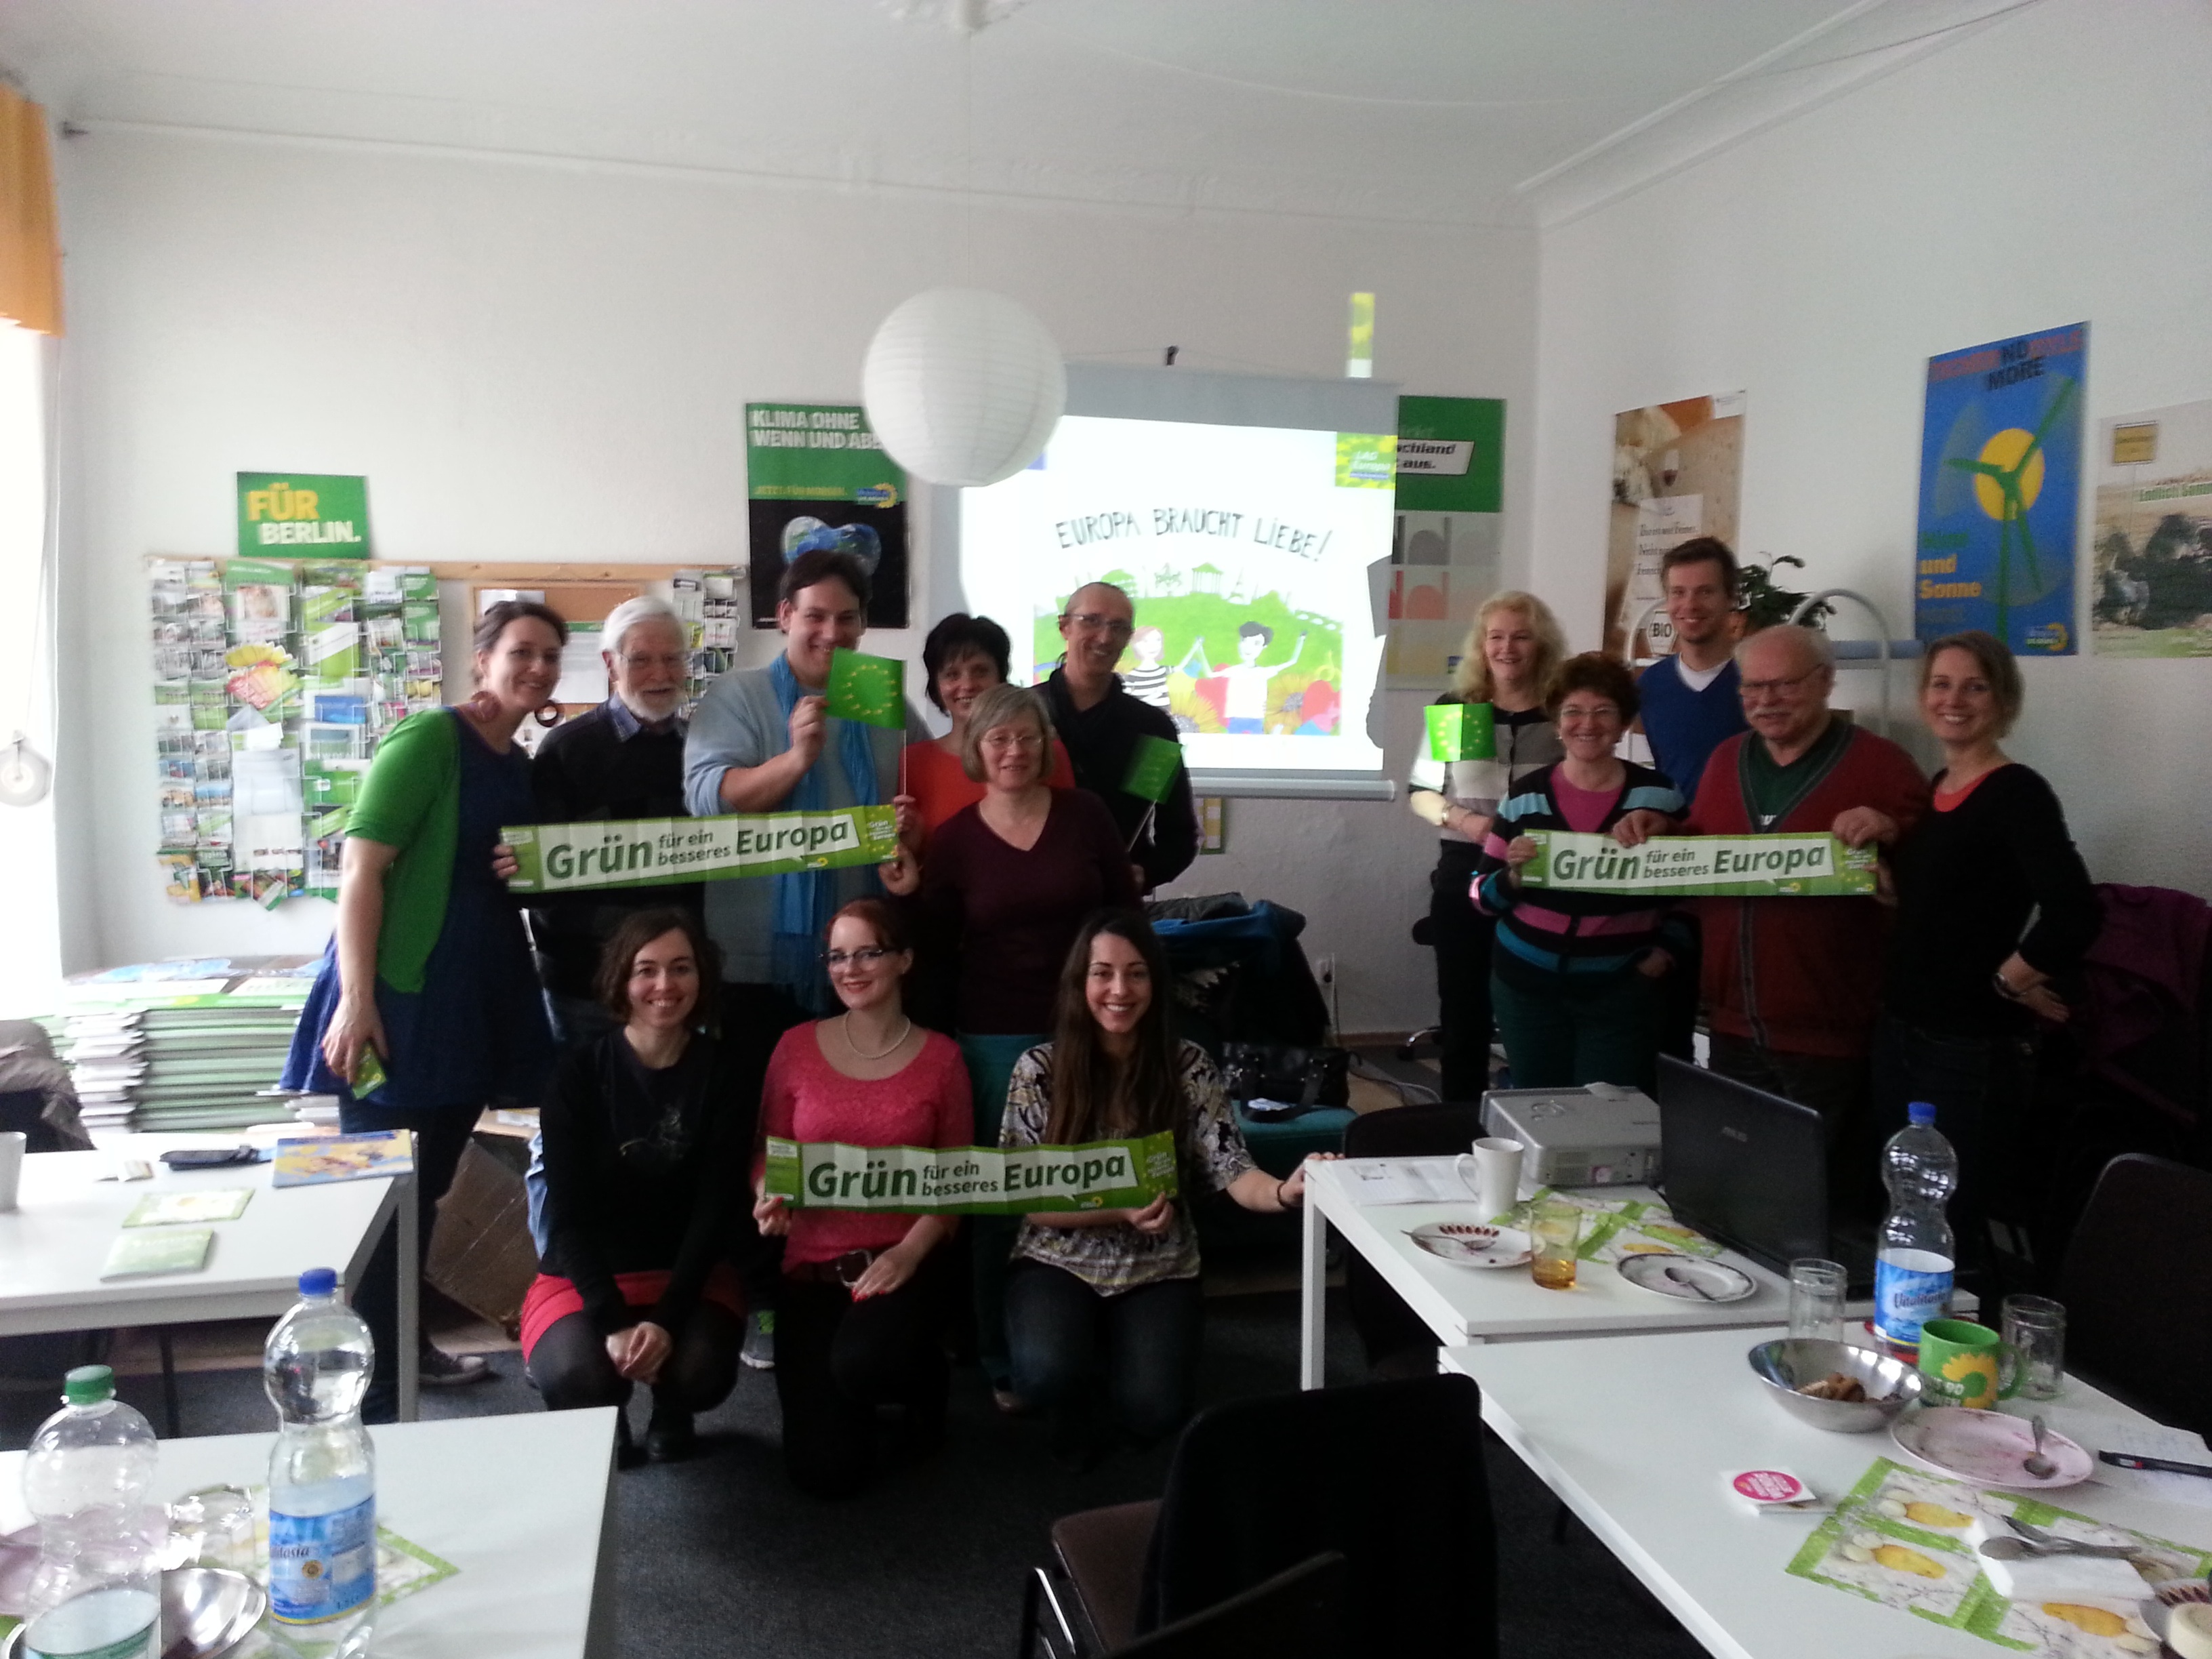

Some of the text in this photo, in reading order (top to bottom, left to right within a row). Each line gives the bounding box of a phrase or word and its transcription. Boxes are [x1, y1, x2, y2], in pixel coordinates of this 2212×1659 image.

[1988, 357, 2045, 390] MORE
[752, 410, 860, 430] KLIMA OHNE
[753, 430, 883, 450] WENN UND ABE
[1403, 459, 1436, 469] aus.
[247, 482, 320, 522] FÜR
[259, 520, 361, 546] BERLIN.
[1056, 511, 1141, 549] EUROPA
[1153, 507, 1244, 536] BRAUCHT
[1920, 553, 1958, 574] und
[1921, 579, 1982, 599] Sonne
[547, 834, 653, 880] Grün
[659, 834, 685, 848] für
[689, 828, 714, 844] ein
[657, 819, 848, 866] besseres Europa
[1553, 847, 1696, 880] Grün für ein
[1643, 862, 1708, 879] besseres
[1714, 845, 1826, 877] Europa
[808, 1160, 980, 1199] Grün für ein
[922, 1177, 998, 1197] besseres
[1004, 1153, 1126, 1192] Europa
